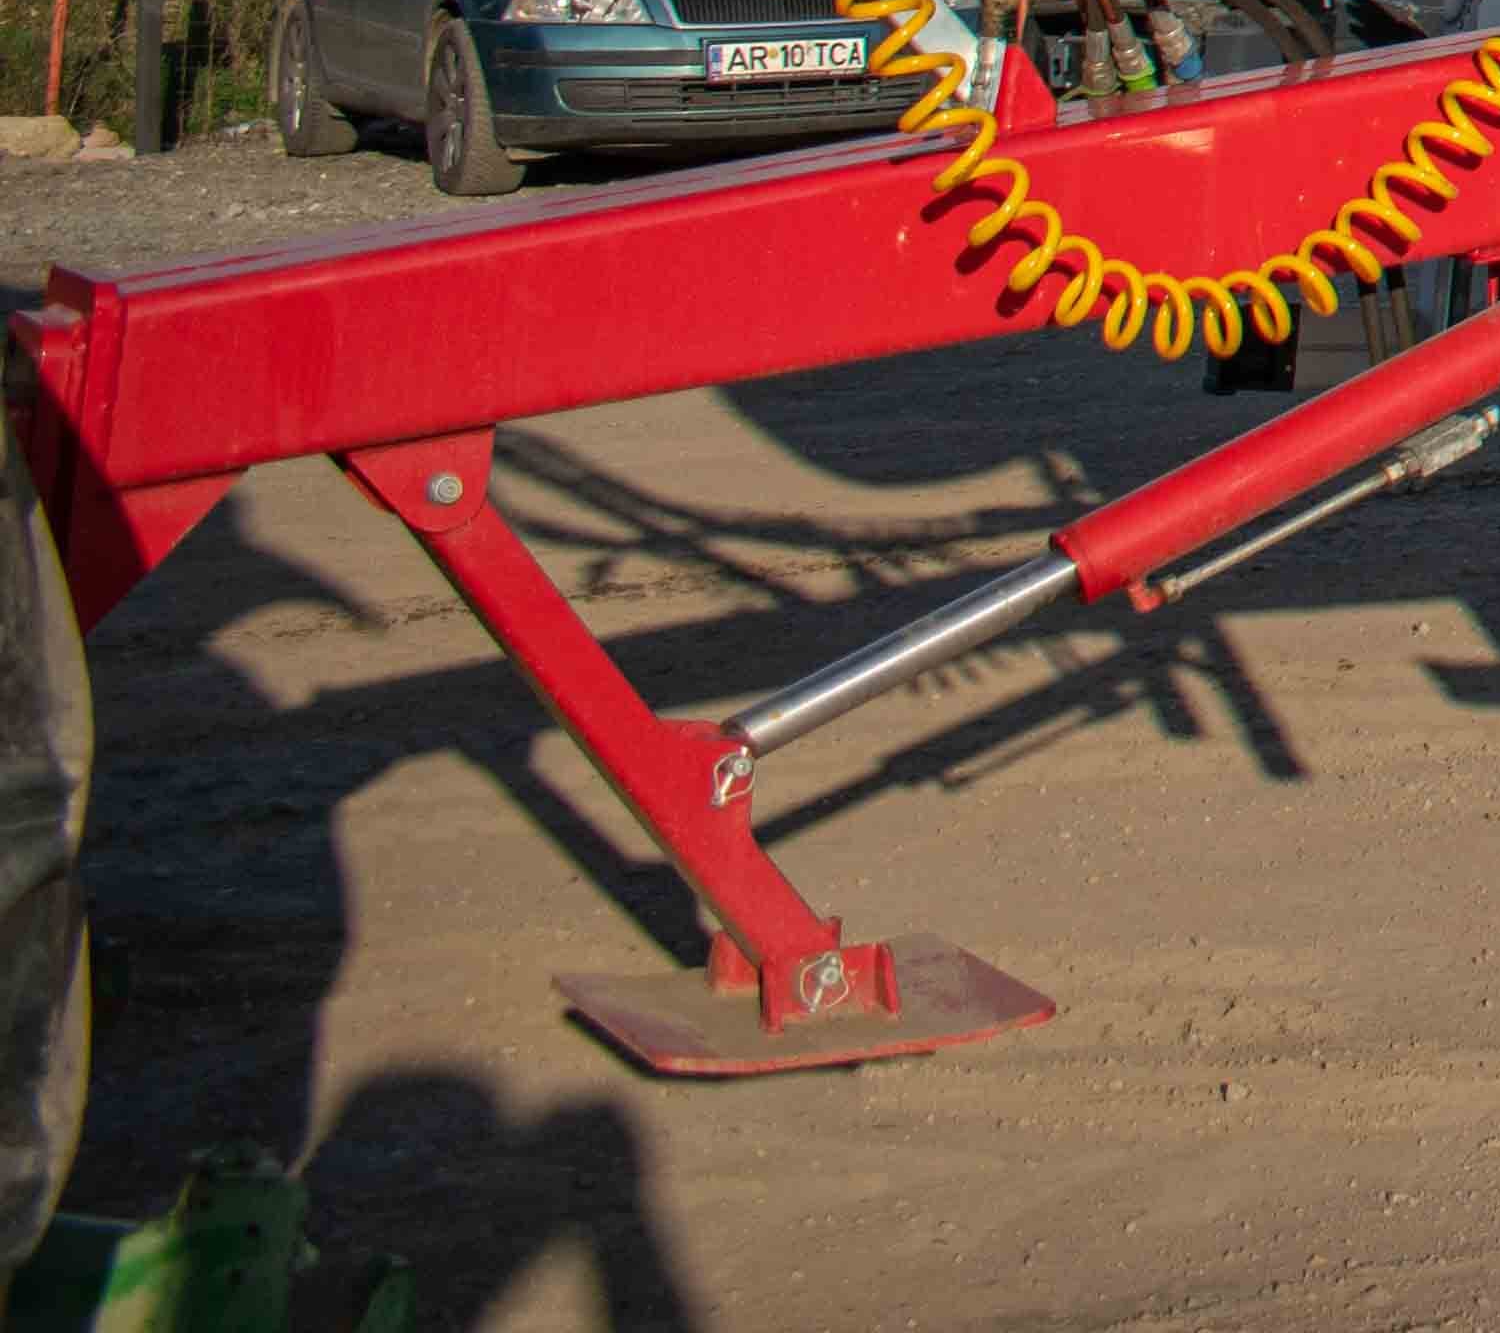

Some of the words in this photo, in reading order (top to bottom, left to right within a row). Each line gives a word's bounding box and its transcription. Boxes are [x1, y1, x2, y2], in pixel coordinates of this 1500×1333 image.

[728, 46, 769, 72] AR
[781, 44, 806, 68] 10
[815, 41, 864, 67] TCA
